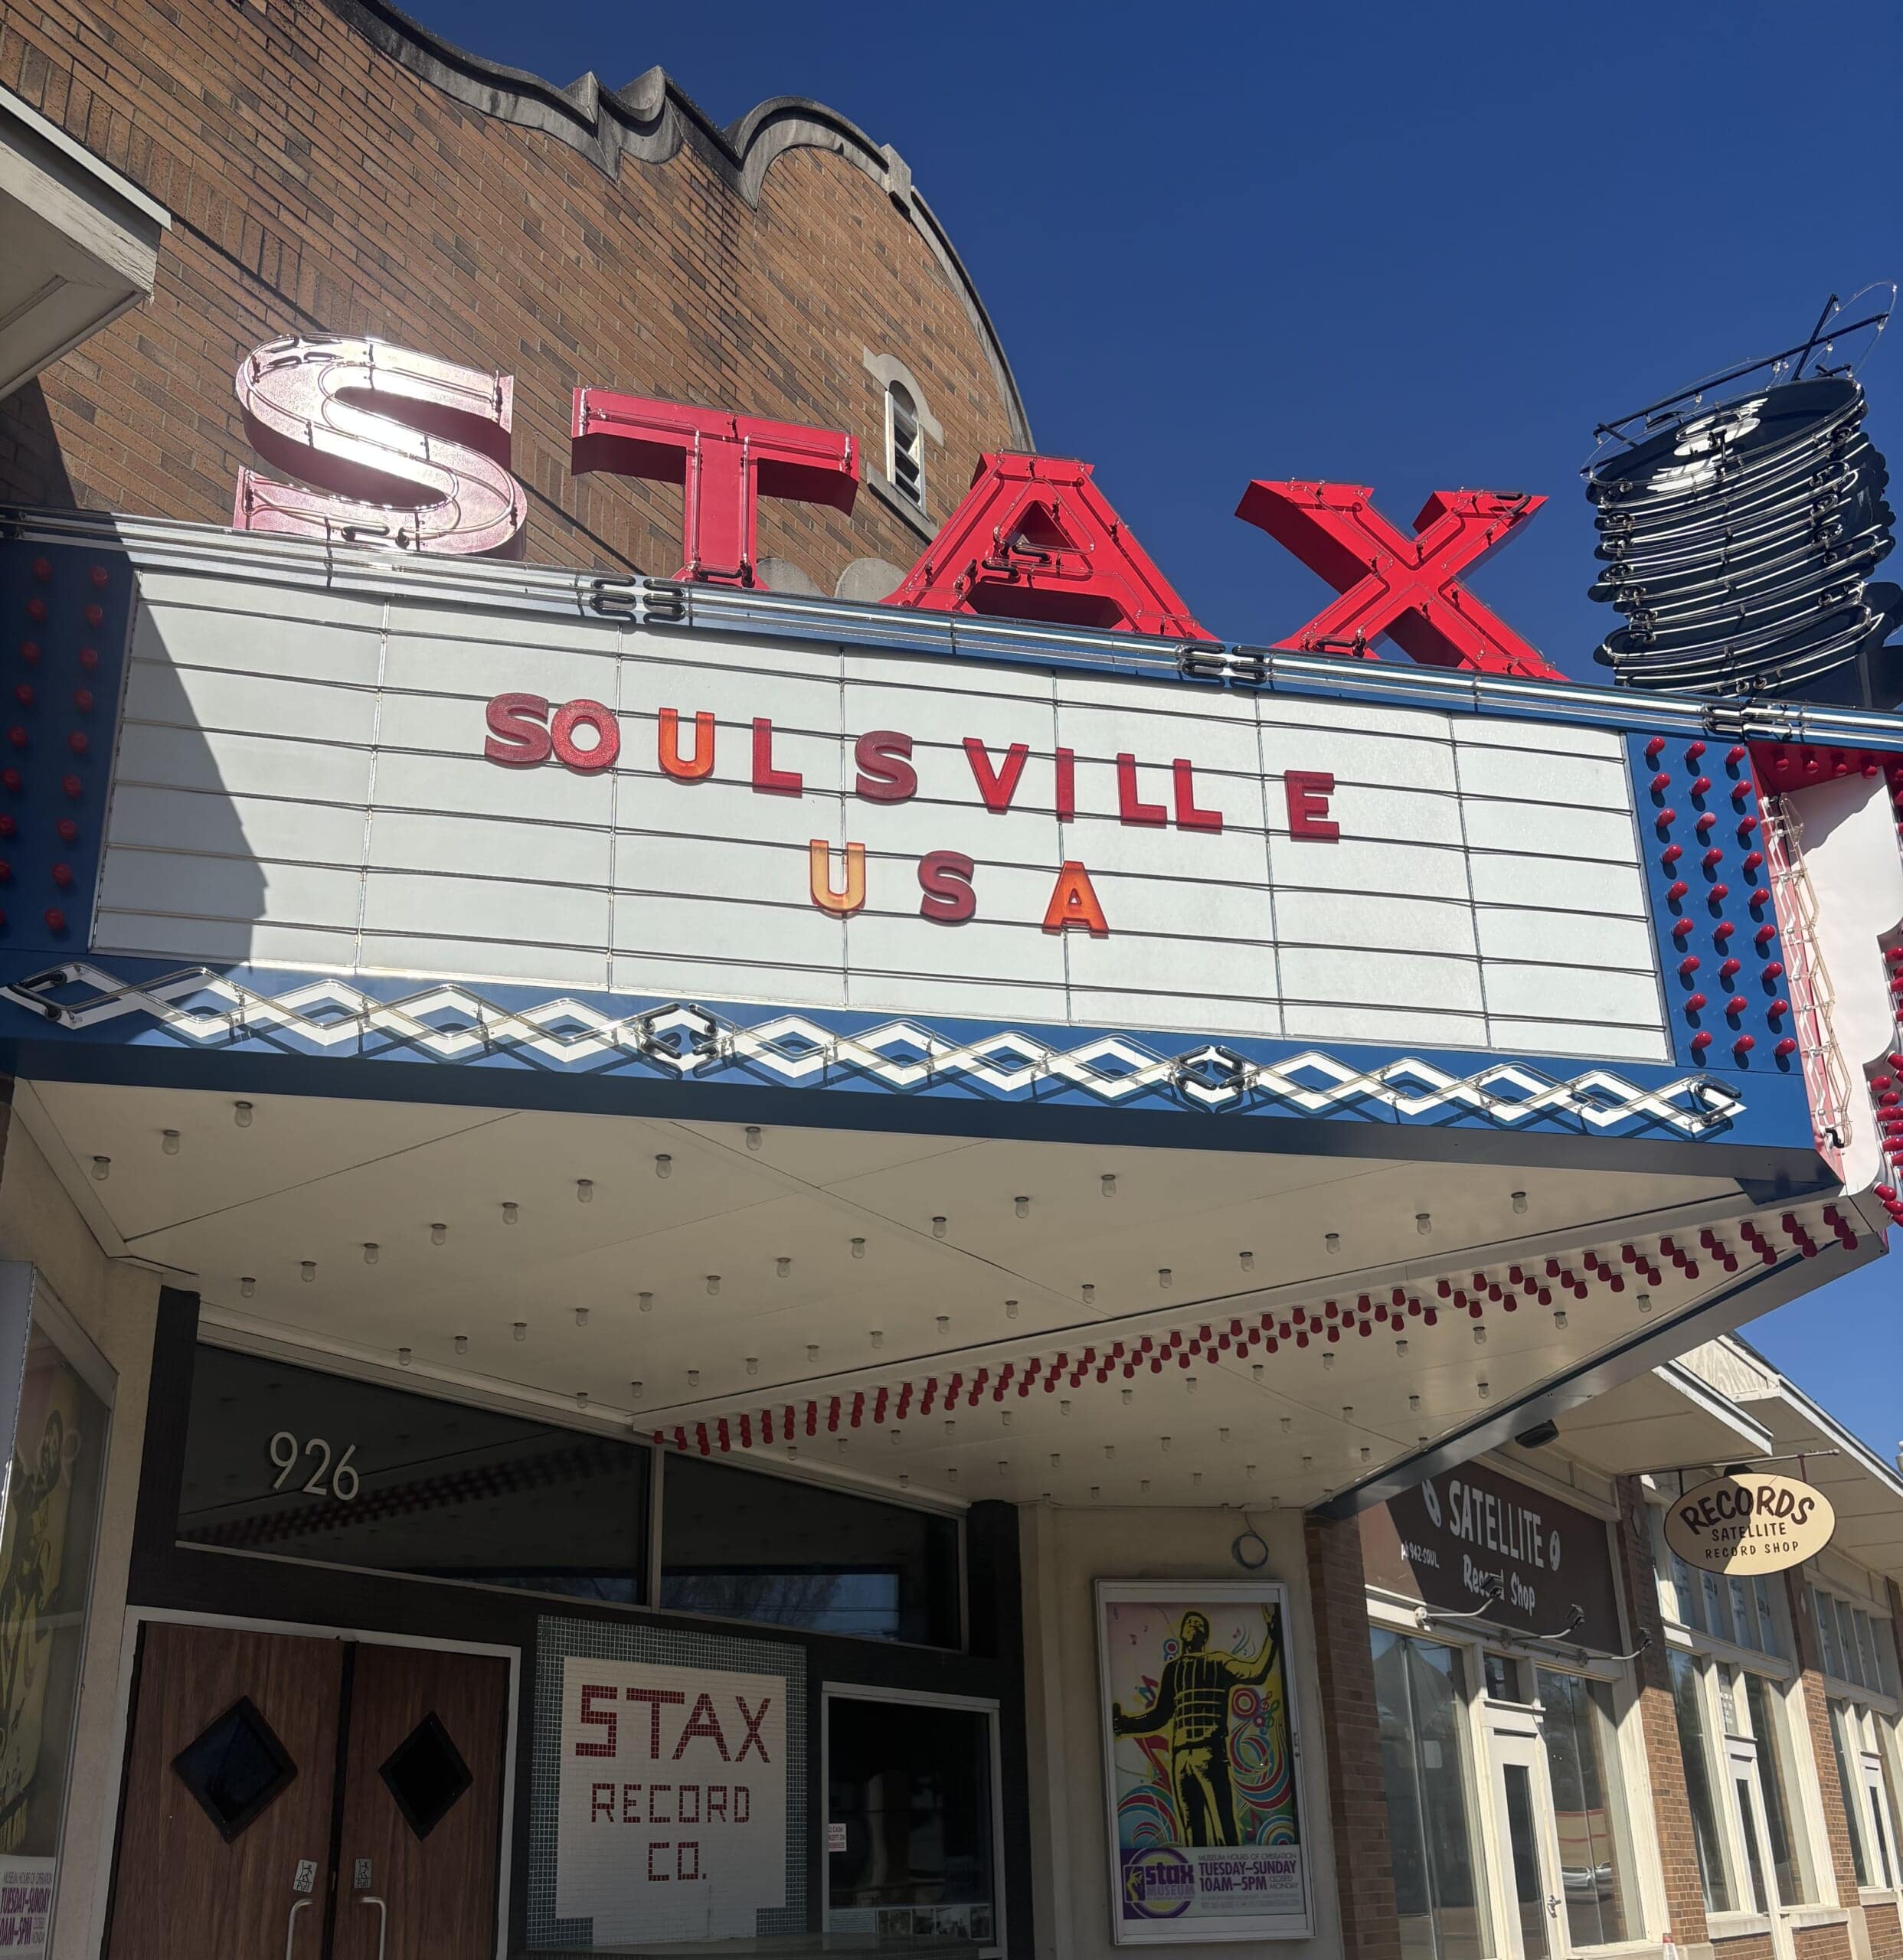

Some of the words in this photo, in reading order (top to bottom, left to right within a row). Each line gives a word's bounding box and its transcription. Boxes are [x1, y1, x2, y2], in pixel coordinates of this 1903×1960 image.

[233, 334, 1572, 681] STAX
[485, 693, 1340, 841] SOULSVILLE
[809, 839, 1109, 939] USA
[270, 1432, 359, 1501] 926
[1449, 1480, 1545, 1568] SATELLITE
[1679, 1486, 1815, 1535] RECORDS
[1712, 1522, 1787, 1541] SATELLITE
[1705, 1545, 1757, 1559] RECORD
[1764, 1541, 1799, 1553] SHOP
[1463, 1553, 1505, 1601] Recd
[1511, 1572, 1535, 1616] Shop
[575, 1684, 771, 1762] STAX
[591, 1783, 750, 1823] RECORD
[296, 1881, 309, 1890] Pull
[649, 1841, 707, 1881] CO.
[1146, 1862, 1194, 1884] stax
[1147, 1885, 1195, 1896] MUSEUM
